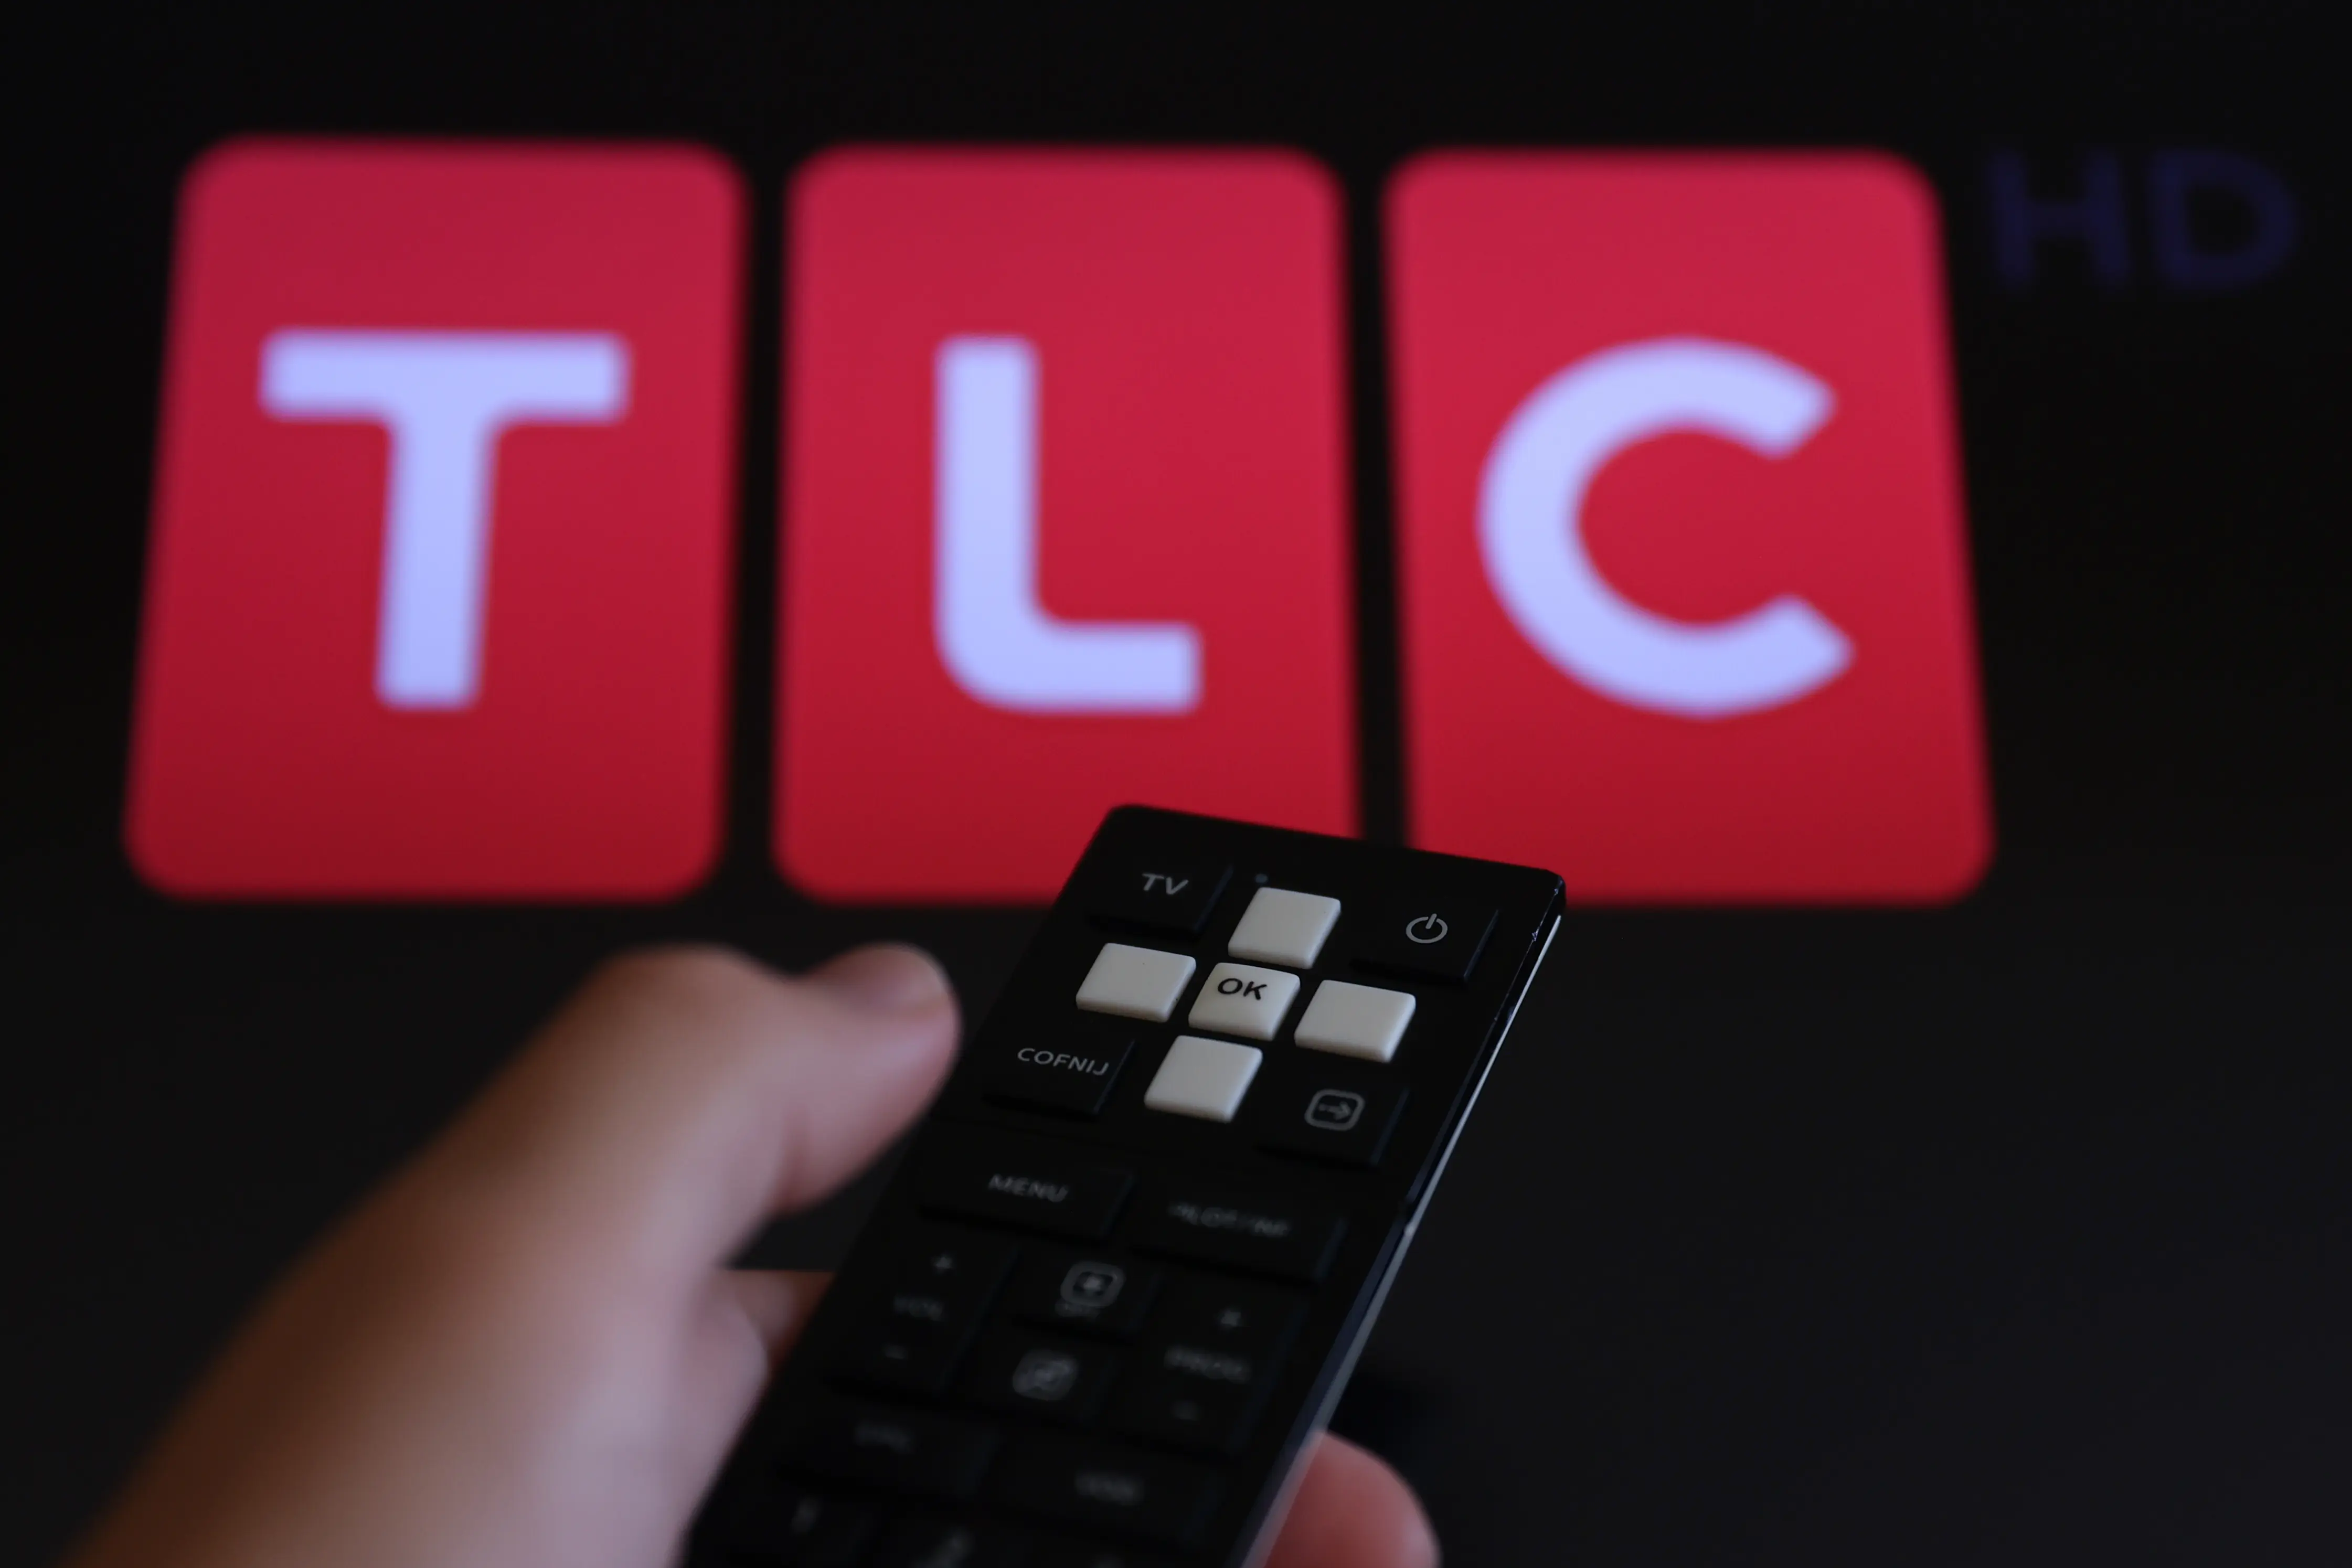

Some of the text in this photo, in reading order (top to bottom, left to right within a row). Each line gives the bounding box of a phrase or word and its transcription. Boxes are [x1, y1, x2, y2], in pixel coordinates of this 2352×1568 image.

[1986, 148, 2299, 291] HD
[1140, 872, 1190, 896] TV
[1216, 977, 1268, 1000] OK
[1016, 1047, 1110, 1077] COFNIJ
[987, 1174, 1068, 1203] MENU
